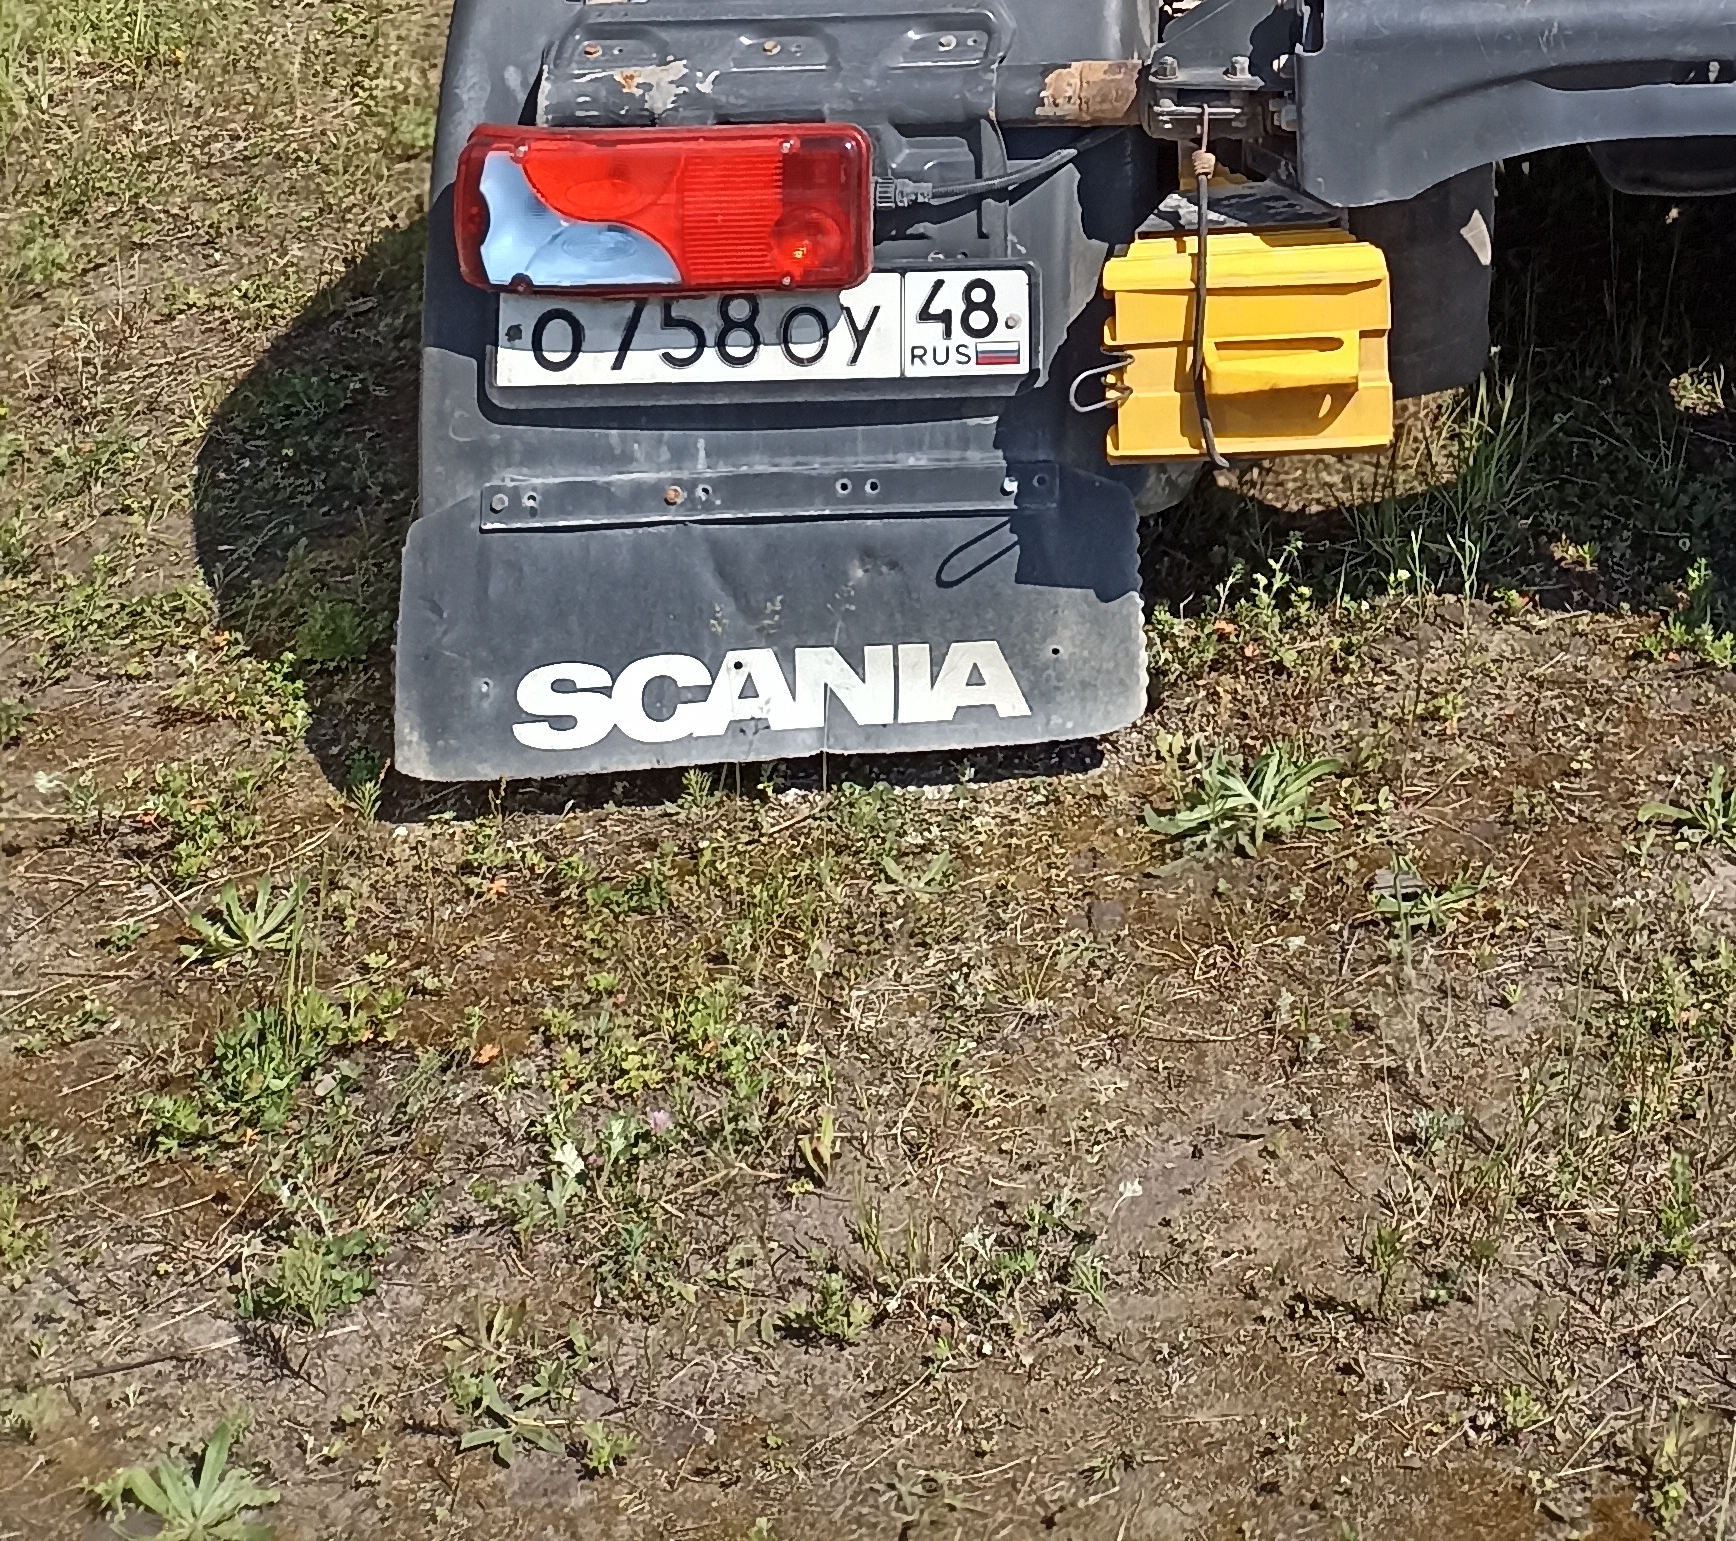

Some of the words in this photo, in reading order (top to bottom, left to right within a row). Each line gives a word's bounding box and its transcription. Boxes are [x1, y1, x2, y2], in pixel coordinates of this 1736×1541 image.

[916, 278, 999, 341] 48
[910, 345, 973, 366] RUS
[511, 640, 1033, 751] SCANIA
